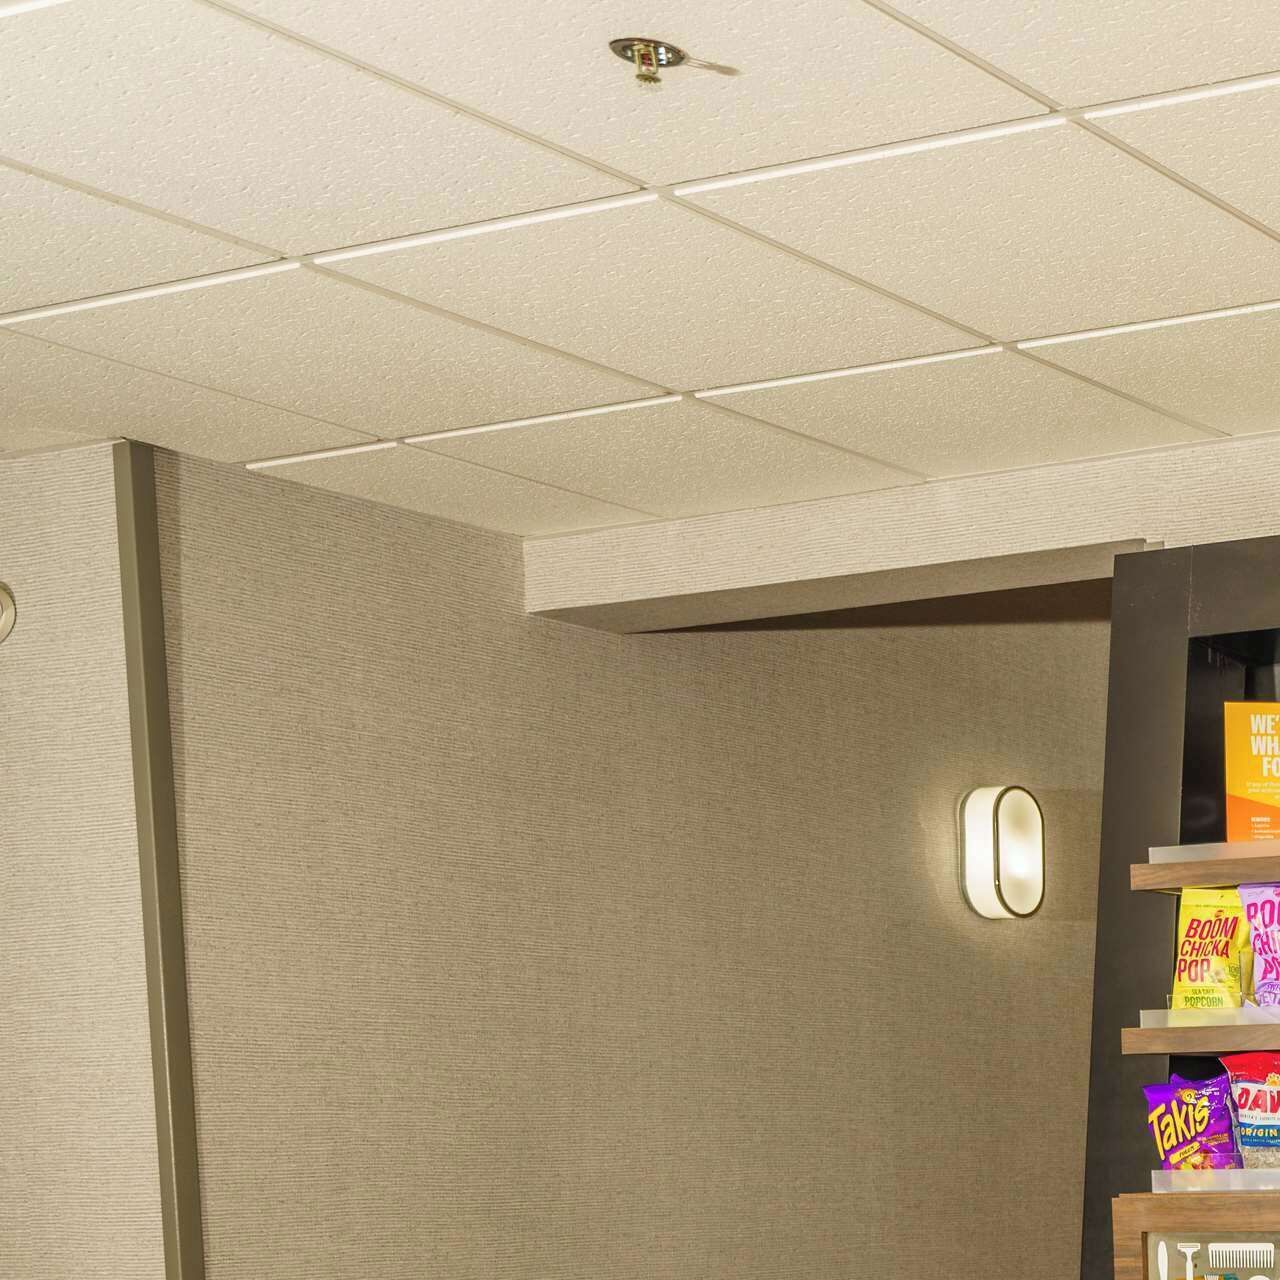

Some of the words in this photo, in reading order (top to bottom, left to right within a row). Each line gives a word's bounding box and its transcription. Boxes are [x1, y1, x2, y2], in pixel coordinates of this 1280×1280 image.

[1185, 916, 1239, 941] BOOM
[1180, 939, 1230, 958] CHICKA
[1178, 958, 1211, 982] POP
[1148, 1096, 1210, 1161] Takis
